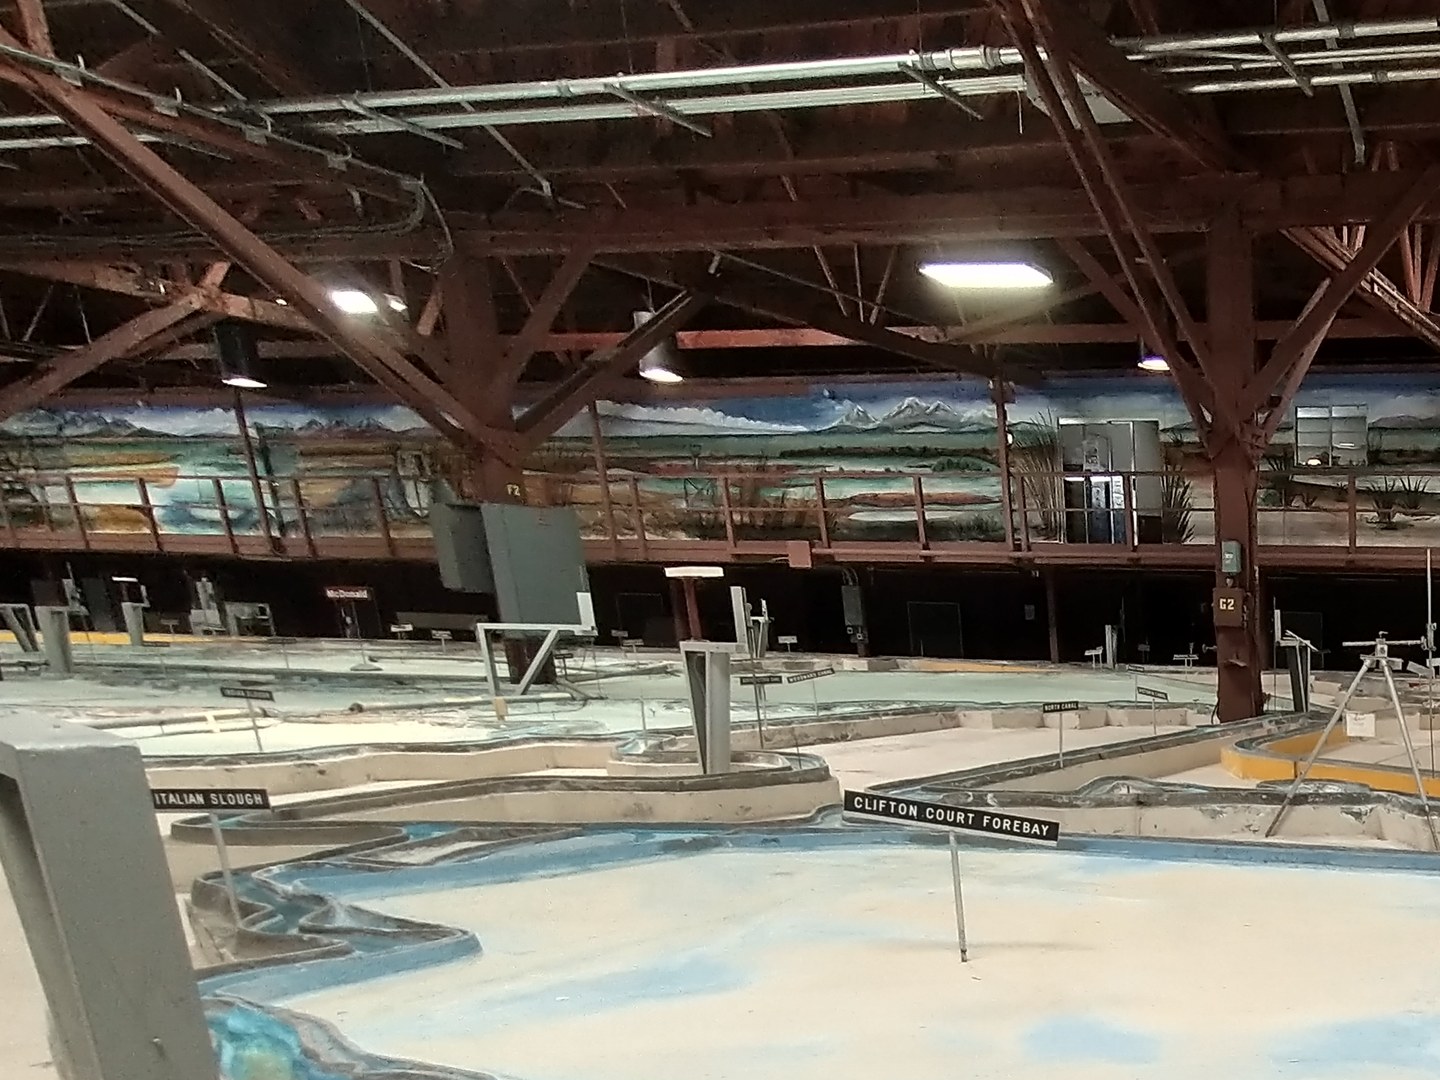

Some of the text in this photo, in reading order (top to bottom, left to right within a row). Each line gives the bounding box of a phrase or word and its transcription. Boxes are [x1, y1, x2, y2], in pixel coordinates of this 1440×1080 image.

[507, 484, 520, 496] F2
[1219, 598, 1235, 610] G2
[1061, 702, 1077, 710] CANAL
[154, 793, 264, 805] ITALIAN SLOUGH
[853, 796, 1050, 837] CLIFTON COURT FOREBAY
